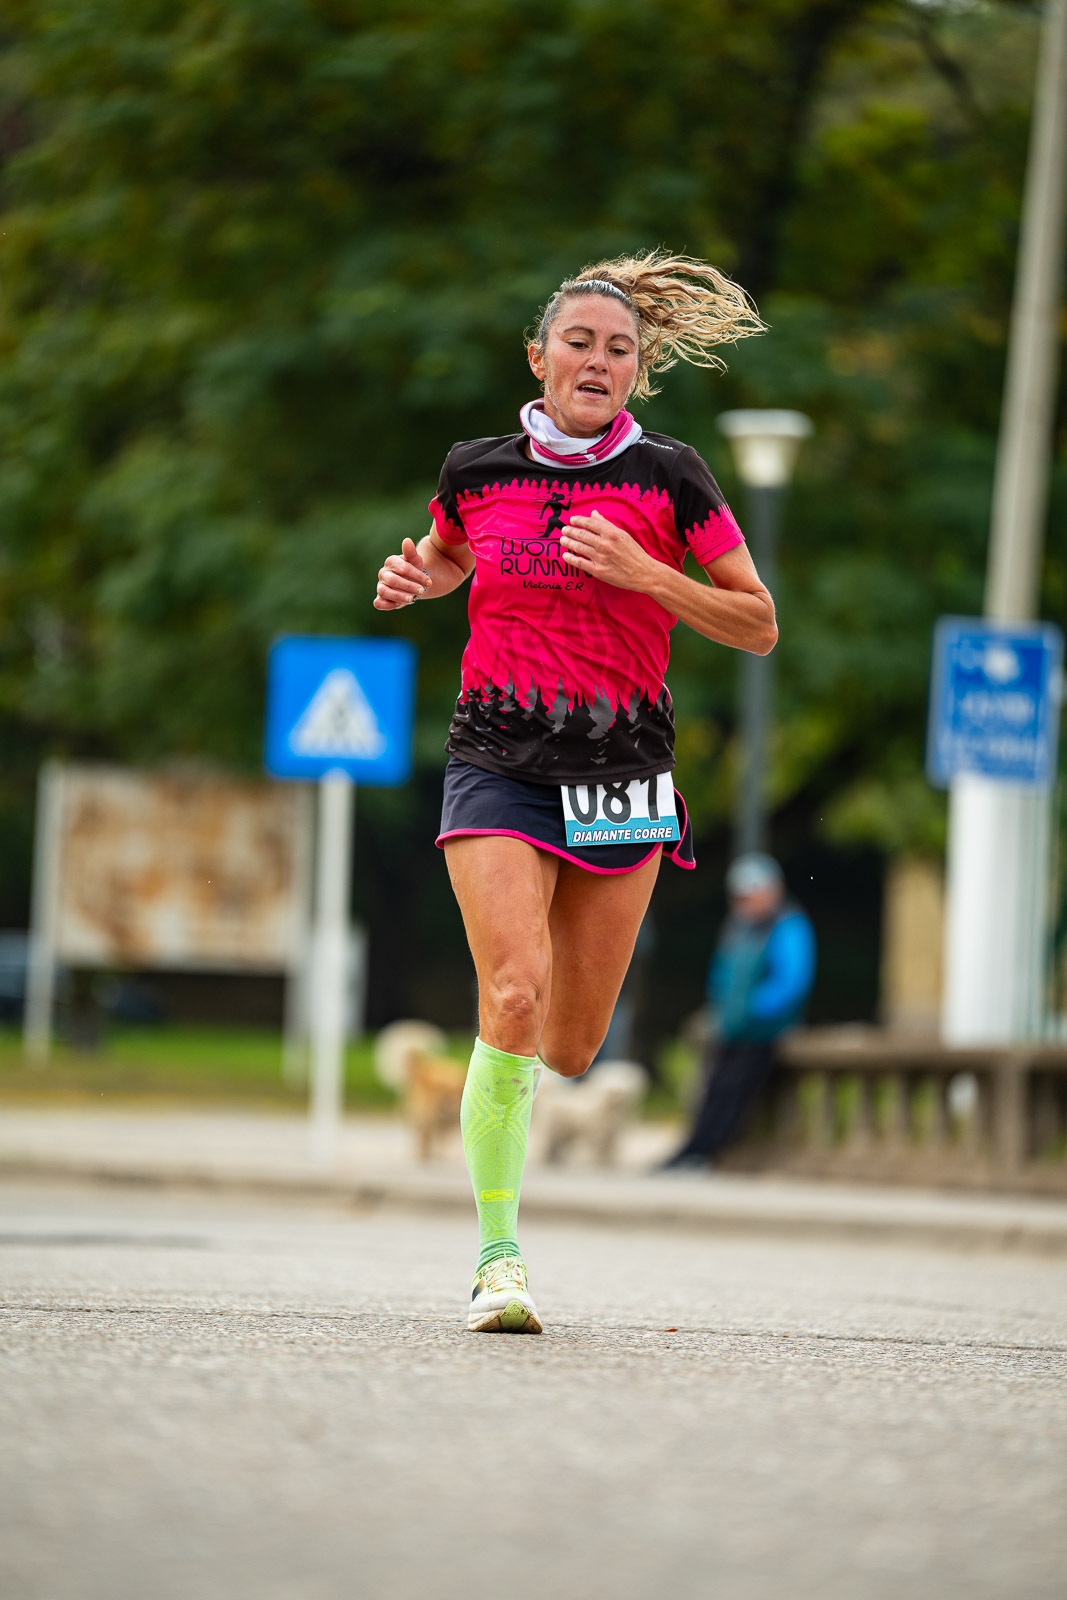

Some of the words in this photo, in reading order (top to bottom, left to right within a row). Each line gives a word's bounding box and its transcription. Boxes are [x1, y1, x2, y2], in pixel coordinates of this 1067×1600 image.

[501, 540, 577, 558] WOM
[500, 558, 593, 578] RUNNI
[523, 580, 562, 590] Victoria
[564, 581, 586, 592] E.R.
[572, 829, 632, 843] DIAMANTE
[634, 827, 673, 840] CORRE
